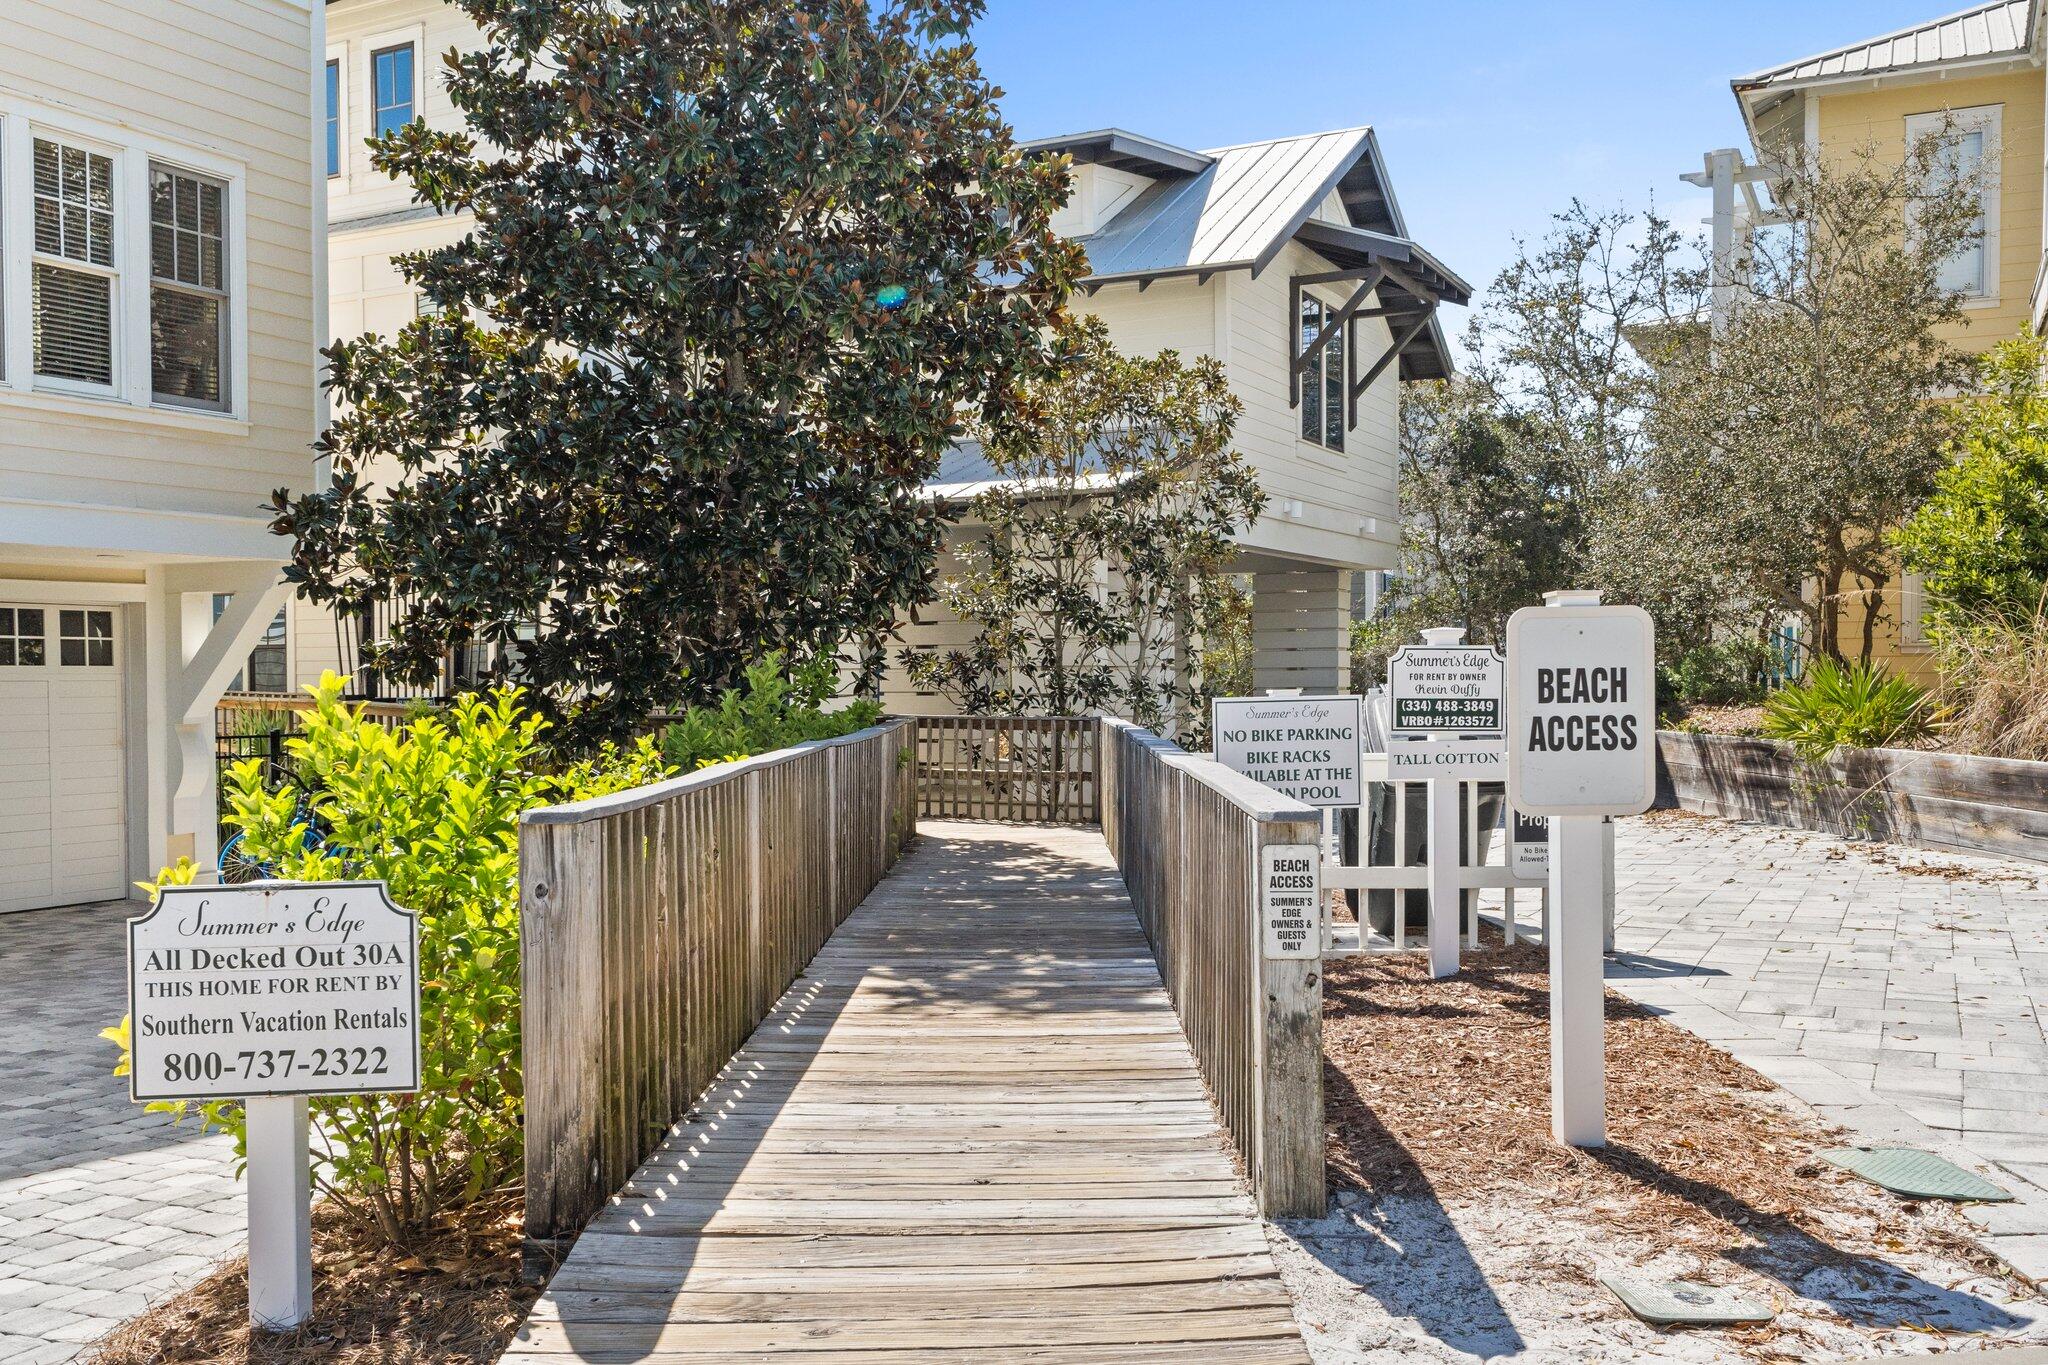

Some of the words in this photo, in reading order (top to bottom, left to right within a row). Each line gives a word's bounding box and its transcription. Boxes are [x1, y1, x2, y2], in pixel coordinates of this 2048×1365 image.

[1405, 653, 1461, 667] Summer's
[1462, 653, 1490, 670] Edge
[1409, 673, 1424, 681] FOR
[1426, 673, 1446, 681] RENT
[1448, 673, 1457, 681] BY
[1460, 673, 1487, 681] OWNER
[1415, 684, 1447, 695] Kevin
[1450, 684, 1481, 697] Duffy
[1537, 667, 1627, 704] BEACH
[1401, 700, 1432, 712] (334)
[1435, 700, 1494, 712] 488-3849
[1245, 705, 1299, 719] Summer's
[1301, 704, 1330, 723] Edge
[1401, 716, 1494, 727] VRBO#1263572
[1223, 729, 1247, 743] NO
[1251, 729, 1283, 742] BIKE
[1287, 727, 1352, 741] PARKING
[1528, 714, 1637, 752] ACCESS
[1246, 751, 1279, 765] BIKE
[1283, 750, 1331, 763] RACKS
[1393, 754, 1432, 765] TALL
[1435, 753, 1500, 765] COTTON
[1236, 769, 1300, 782] AILABLE
[1304, 768, 1322, 781] AT
[1325, 767, 1353, 780] THE
[1300, 786, 1342, 800] POOL
[1273, 860, 1310, 872] BEACH
[1270, 876, 1314, 888] ACCESS
[1270, 898, 1312, 907] SUMMER'S
[178, 899, 296, 937] Summer's
[305, 896, 365, 943] Edge
[1282, 909, 1302, 918] EDGE
[1271, 920, 1304, 929] OWNERS
[1306, 920, 1312, 929] &
[1277, 931, 1306, 940] GUESTS
[1282, 942, 1302, 951] ONLY
[143, 950, 181, 971] All
[191, 947, 286, 970] Decked
[295, 945, 347, 968] Out
[353, 943, 405, 966] 30A
[145, 981, 193, 998] THIS
[200, 979, 262, 996] HOME
[268, 977, 310, 995] FOR
[315, 976, 370, 993] RENT
[375, 975, 403, 991] BY
[142, 1013, 234, 1037] Southern
[240, 1009, 327, 1033] Vacation
[333, 1007, 408, 1031] Rentals
[163, 1046, 389, 1082] 800-737-2322
